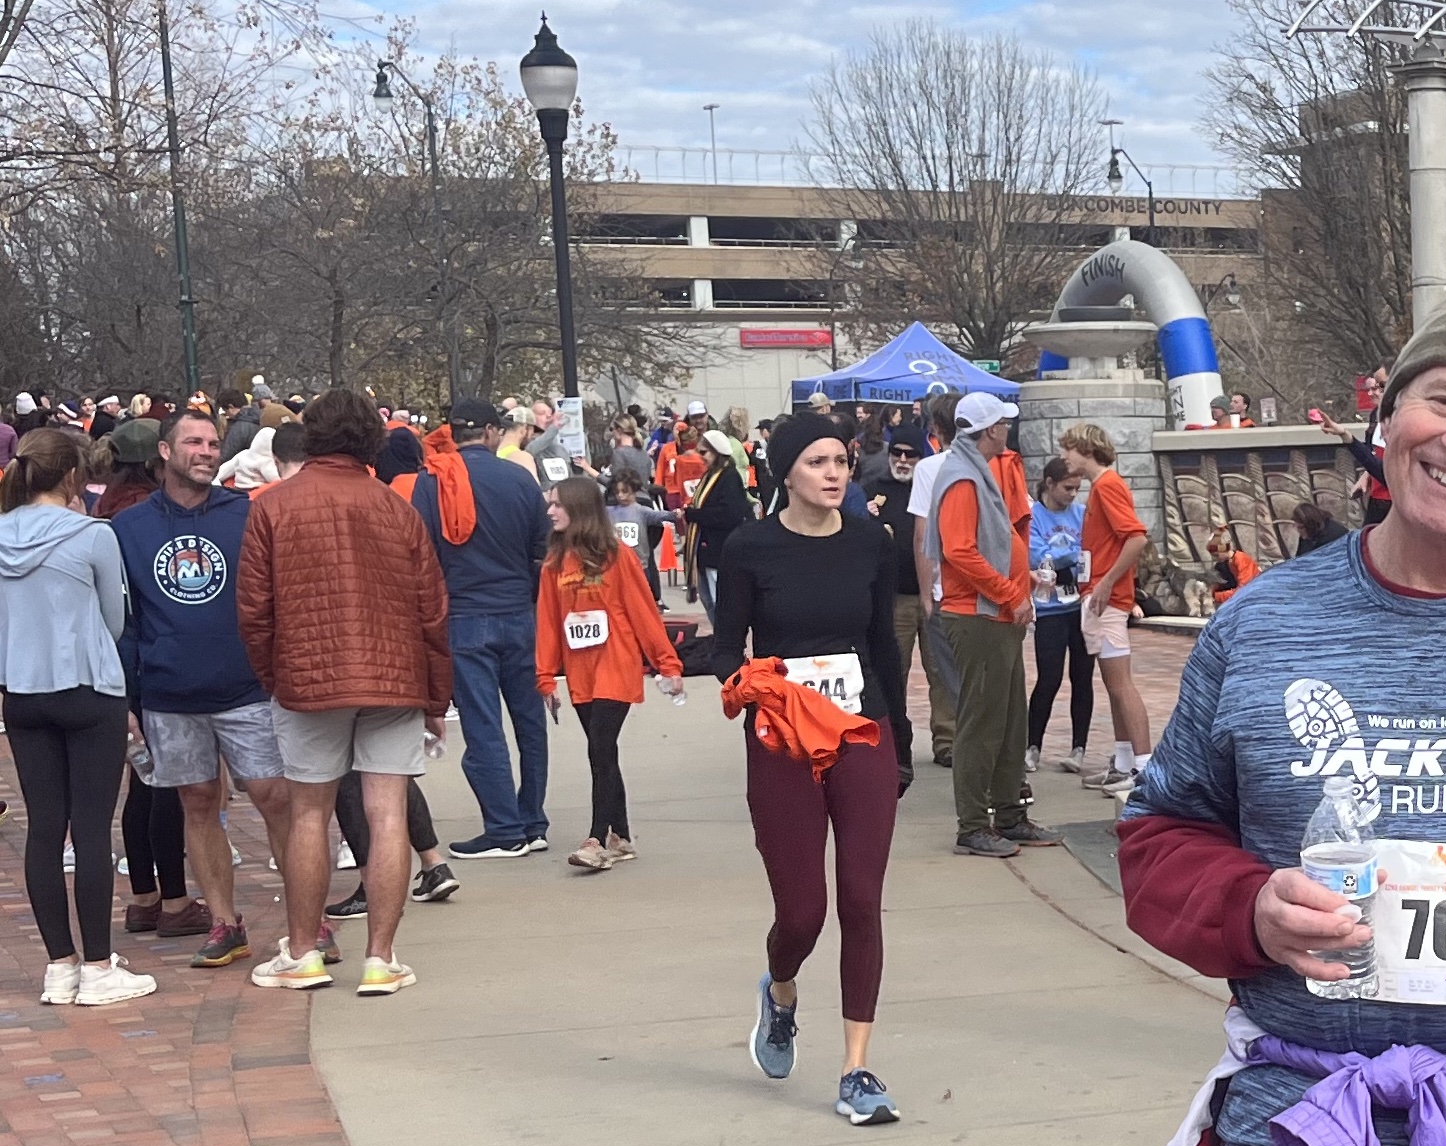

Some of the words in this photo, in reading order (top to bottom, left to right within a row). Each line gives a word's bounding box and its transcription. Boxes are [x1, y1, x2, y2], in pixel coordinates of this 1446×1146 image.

[1153, 200, 1223, 215] COUNTY
[1081, 254, 1125, 287] FINISH
[870, 387, 912, 401] RIGHT
[188, 539, 224, 572] DSIGN
[568, 623, 601, 639] 1028
[1368, 714, 1390, 728] We
[1392, 717, 1416, 729] run
[1419, 718, 1436, 730] on
